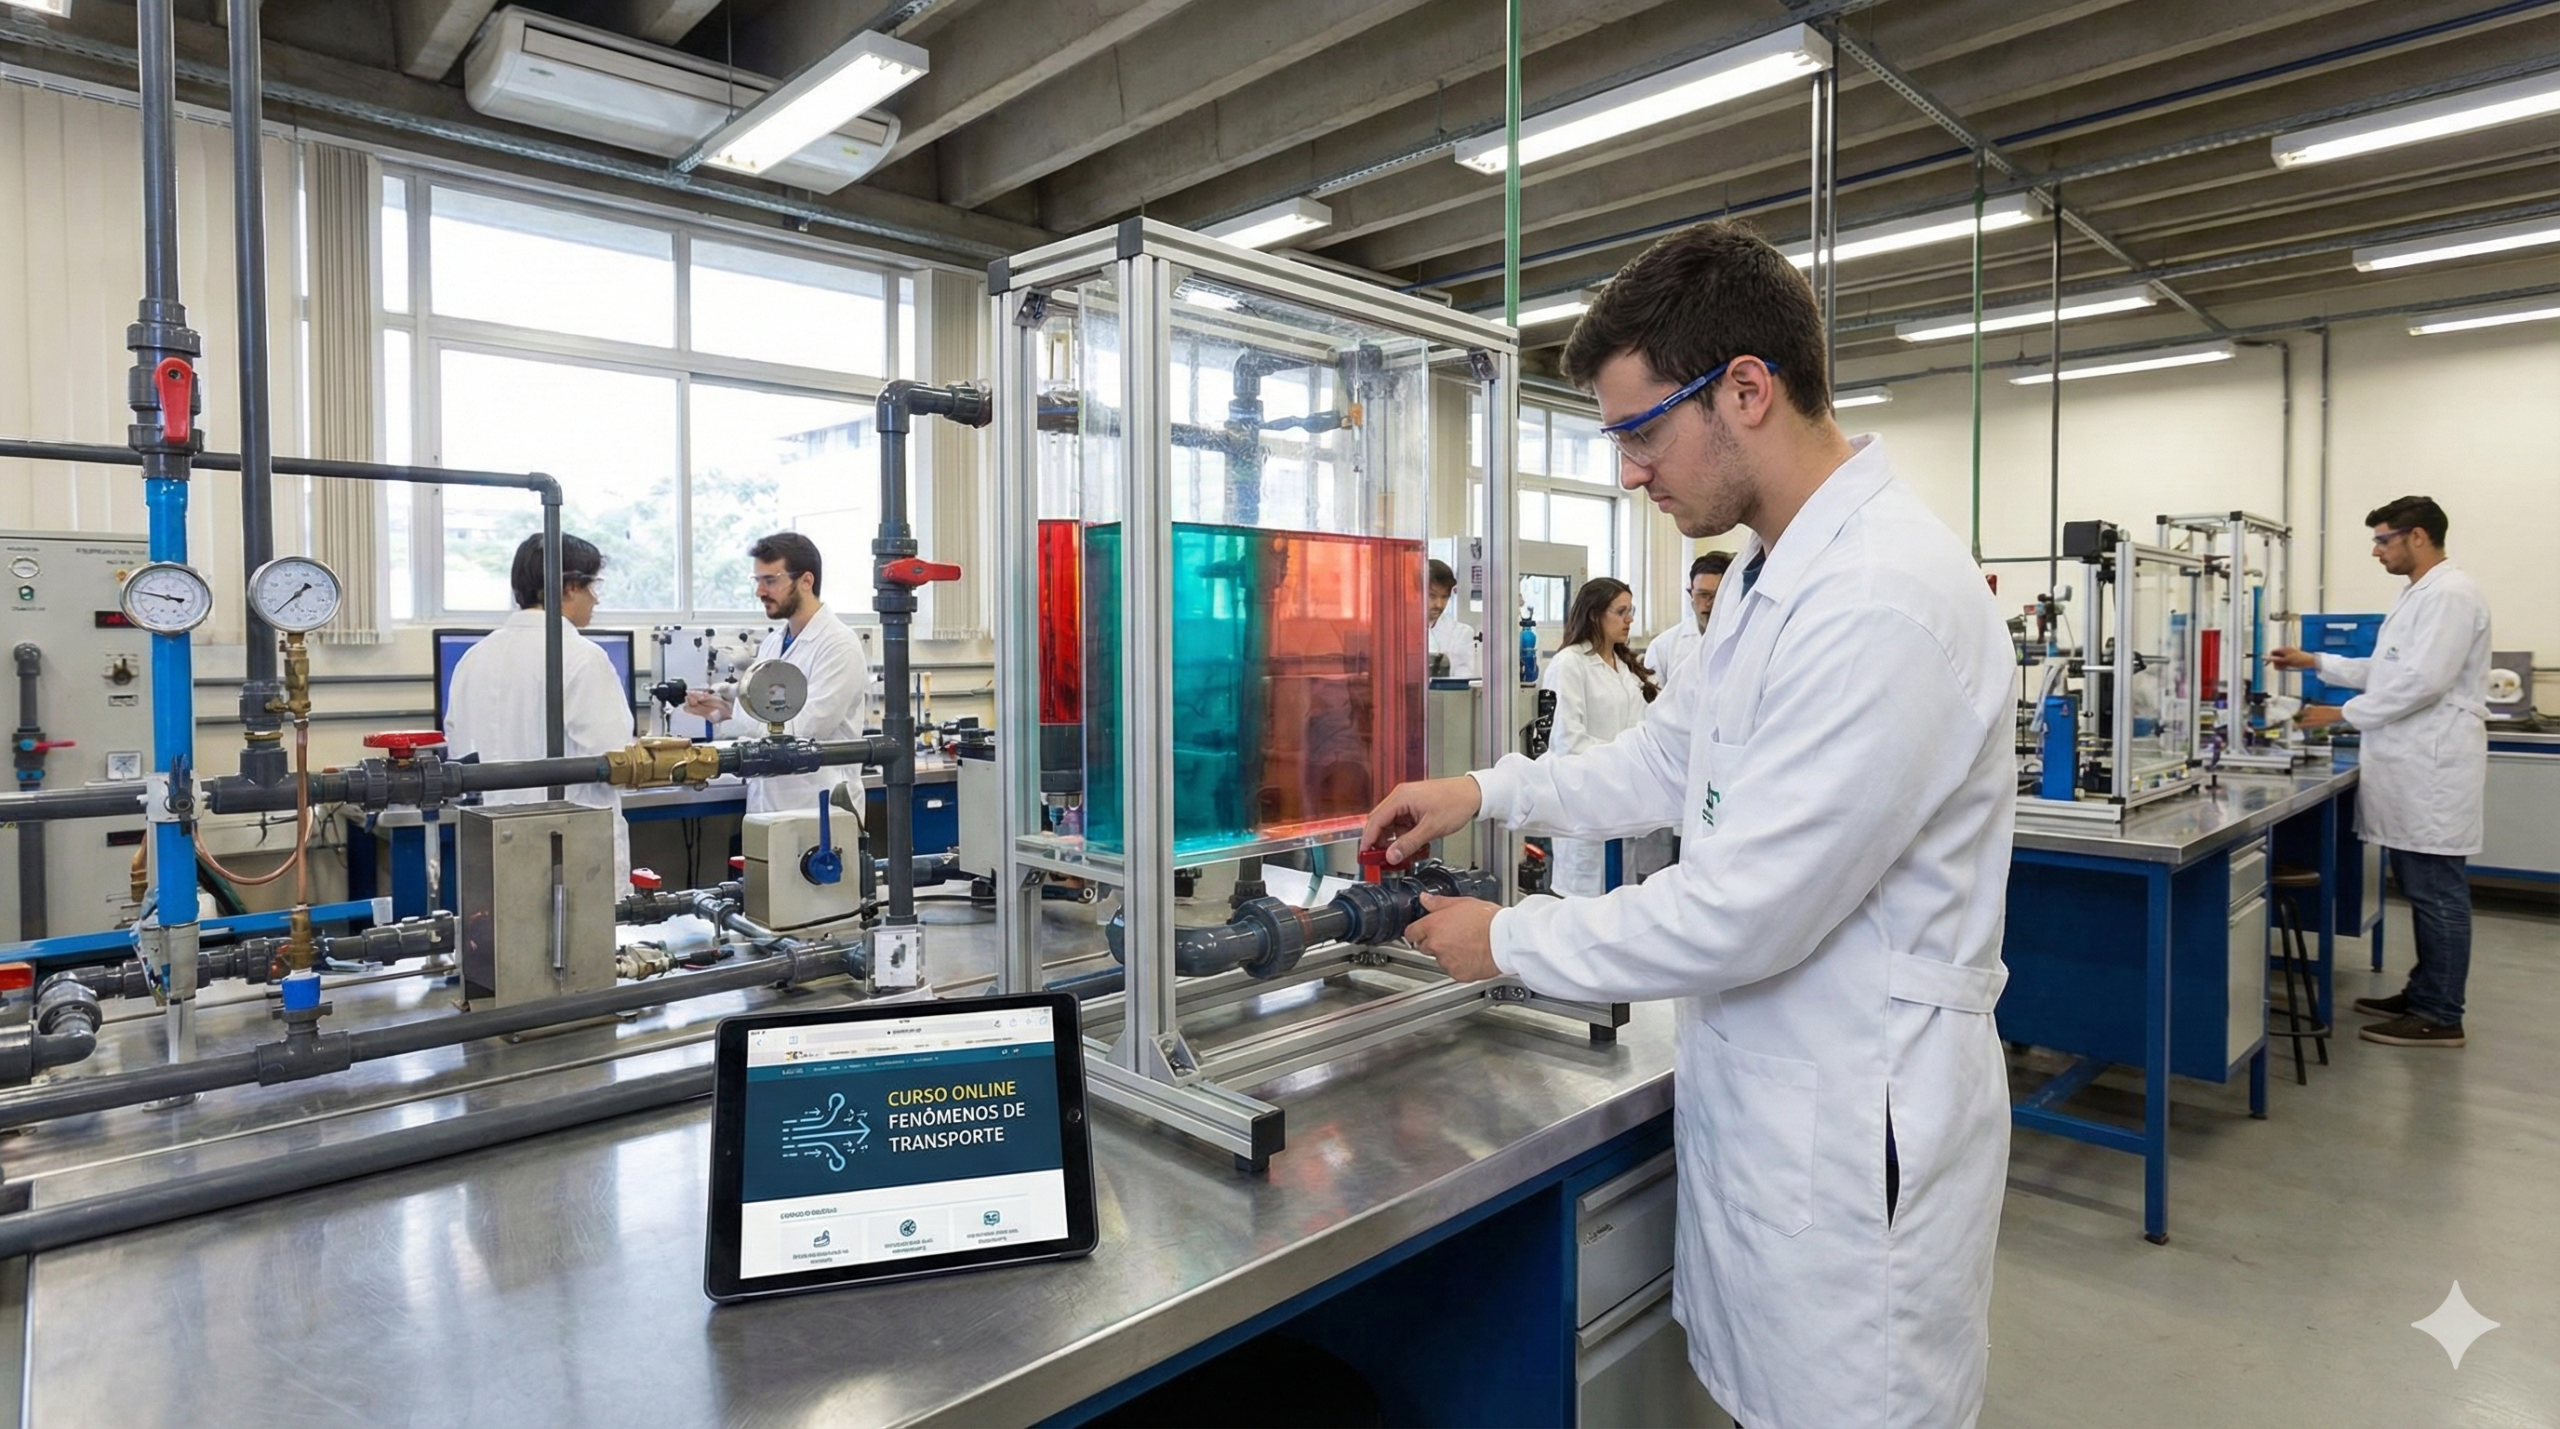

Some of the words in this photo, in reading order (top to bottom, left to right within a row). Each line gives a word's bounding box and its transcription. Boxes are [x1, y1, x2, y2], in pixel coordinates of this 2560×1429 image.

[888, 1086, 948, 1107] CURSO
[951, 1081, 1017, 1101] ONLINE
[888, 1105, 999, 1130] FENÔMENOS
[1003, 1102, 1026, 1119] DE
[888, 1126, 1005, 1153] TRANSPORTE
